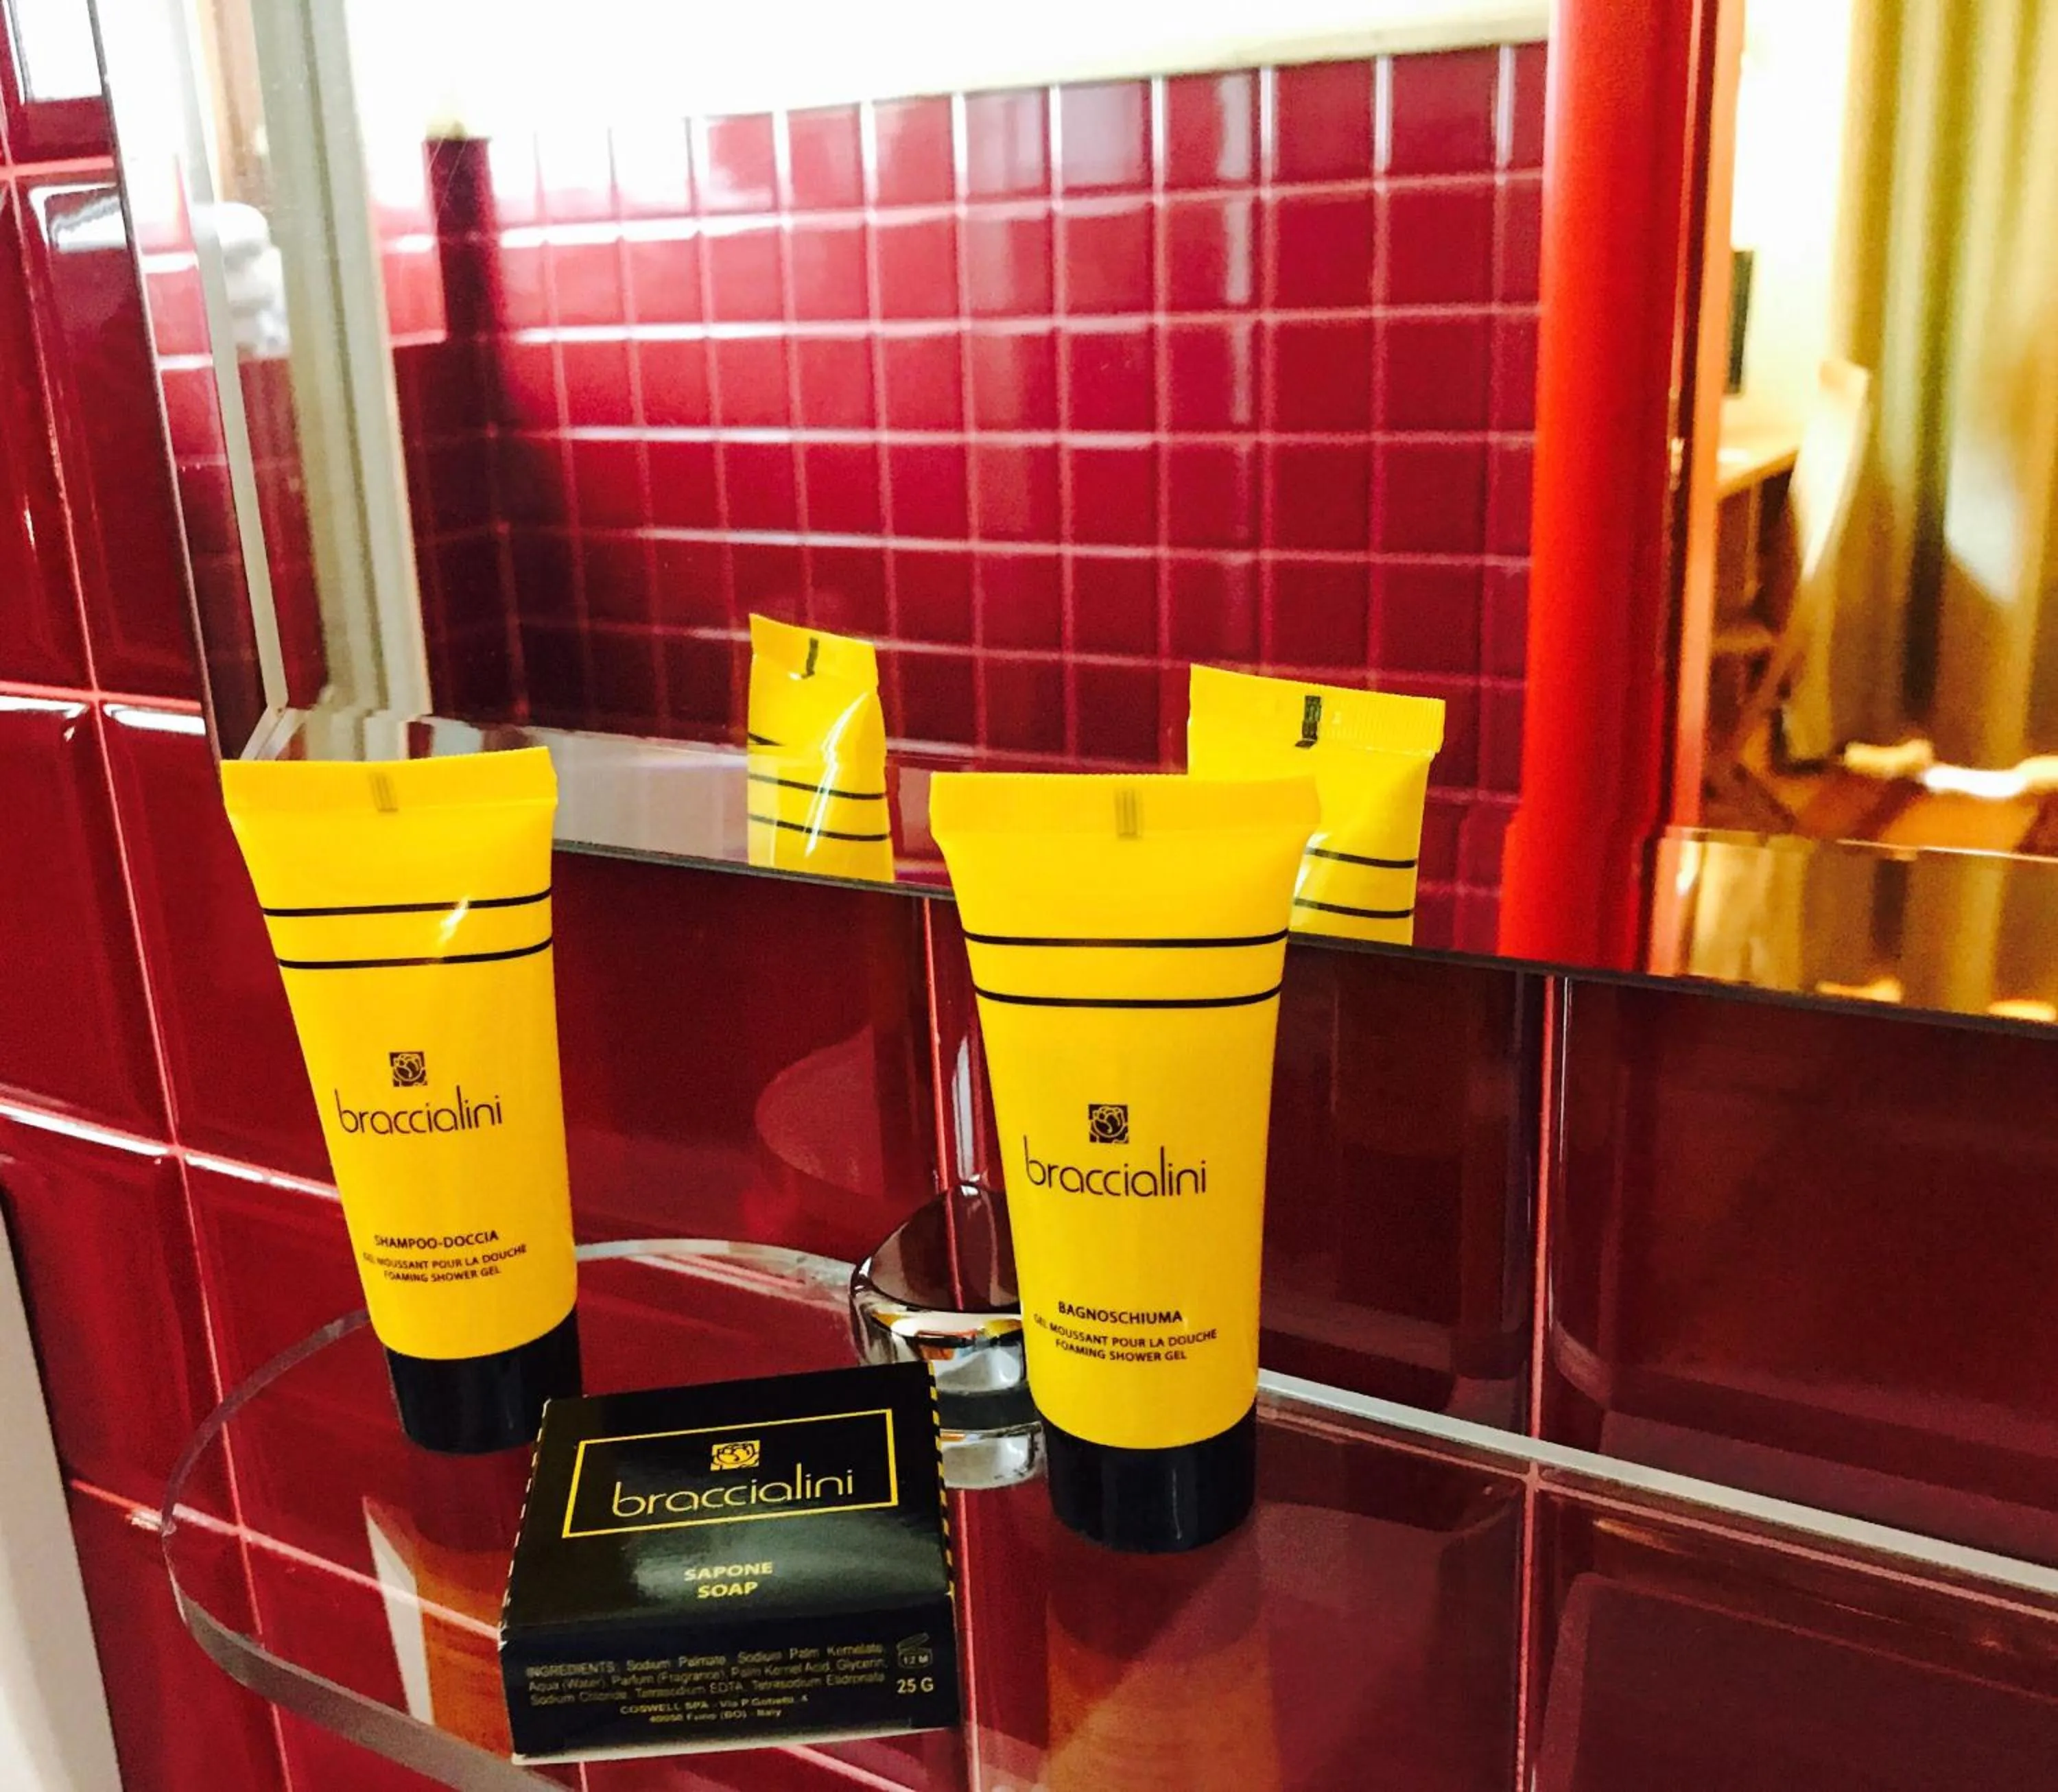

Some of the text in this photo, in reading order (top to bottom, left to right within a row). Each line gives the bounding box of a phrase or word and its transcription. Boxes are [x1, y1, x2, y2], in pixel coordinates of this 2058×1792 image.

[335, 1085, 502, 1134] braccialini
[1024, 1135, 1206, 1197] braccialini
[375, 1230, 499, 1249] SHAMPOO-DOCCIA
[377, 1257, 428, 1269] MOUSSANT
[432, 1260, 462, 1269] POUR
[465, 1258, 478, 1266] LA
[482, 1244, 527, 1263] DOUCHE
[384, 1266, 500, 1282] FOAMING SHOWER GEL
[1058, 1301, 1183, 1324] BAGNOSCHIUMA
[1034, 1313, 1218, 1347] GEL MOUSSANT POUR LA DOUCHE
[1056, 1339, 1187, 1361] FOAMING SHOWER GEL
[613, 1463, 853, 1517] braccialini
[684, 1562, 773, 1581] SAPONE
[698, 1582, 758, 1599] SOAP
[897, 1677, 934, 1694] 25 G
